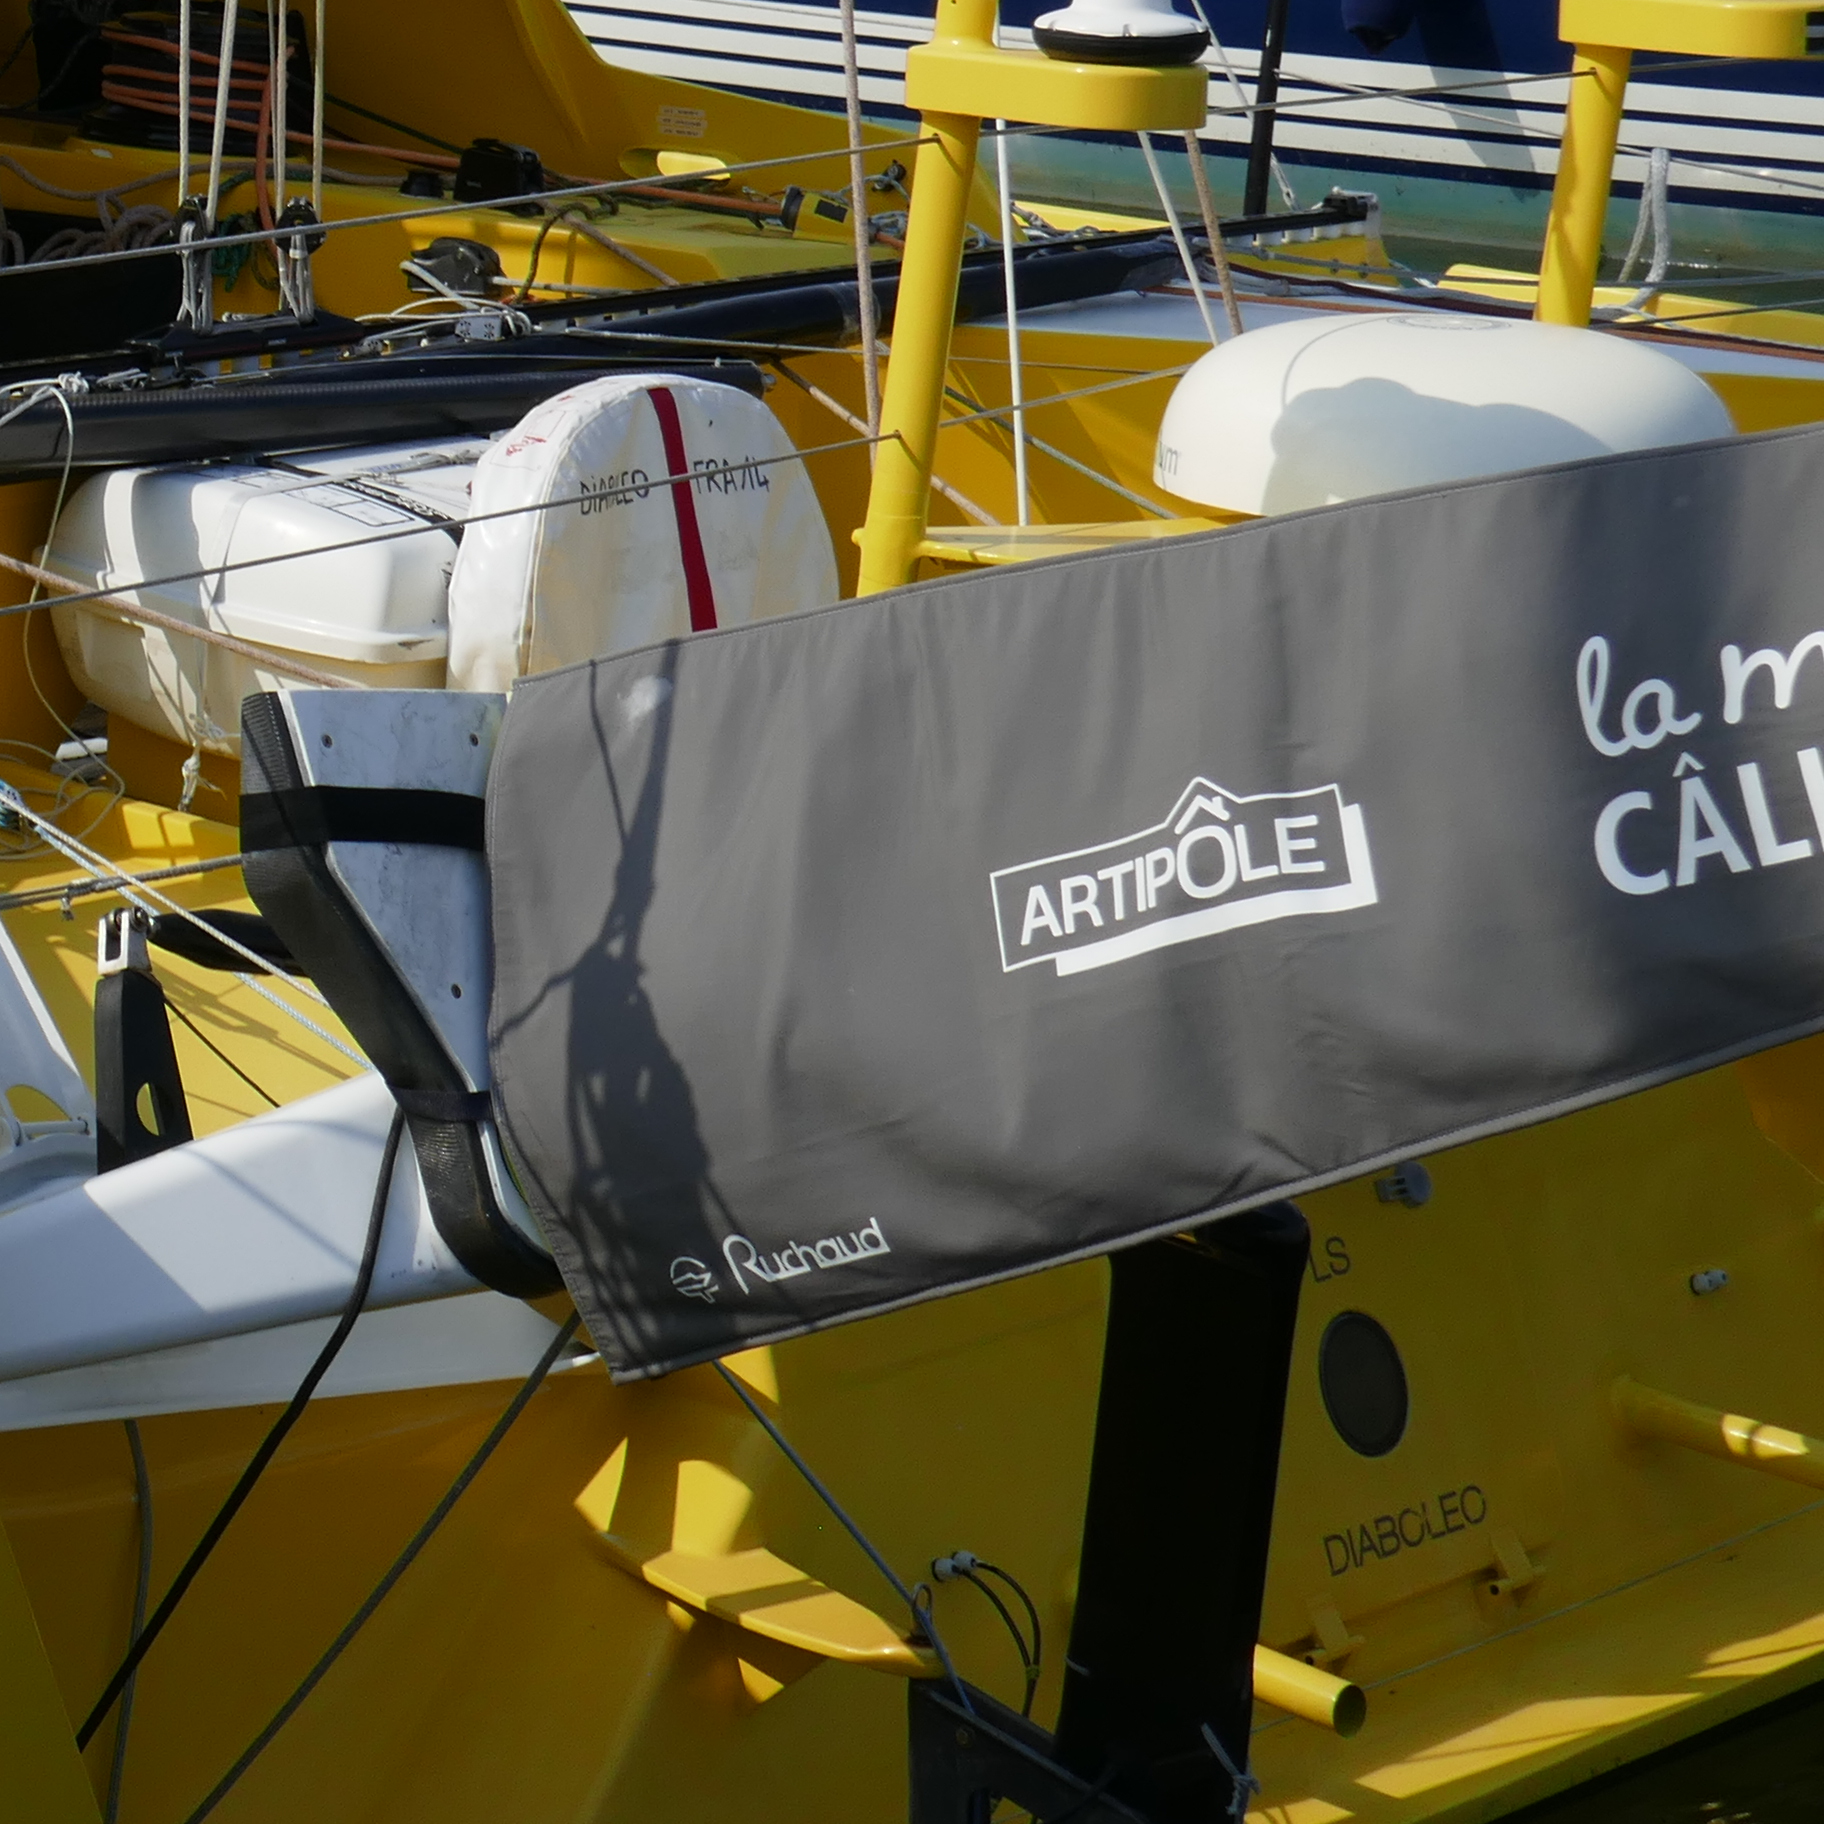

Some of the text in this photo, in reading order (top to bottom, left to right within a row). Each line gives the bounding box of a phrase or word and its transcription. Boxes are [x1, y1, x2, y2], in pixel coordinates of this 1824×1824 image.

[1575, 636, 1702, 757] la
[1019, 795, 1325, 945] ARTIPÔLE
[722, 1217, 891, 1295] Ruchaud
[1323, 1485, 1486, 1576] DIABOLEO
